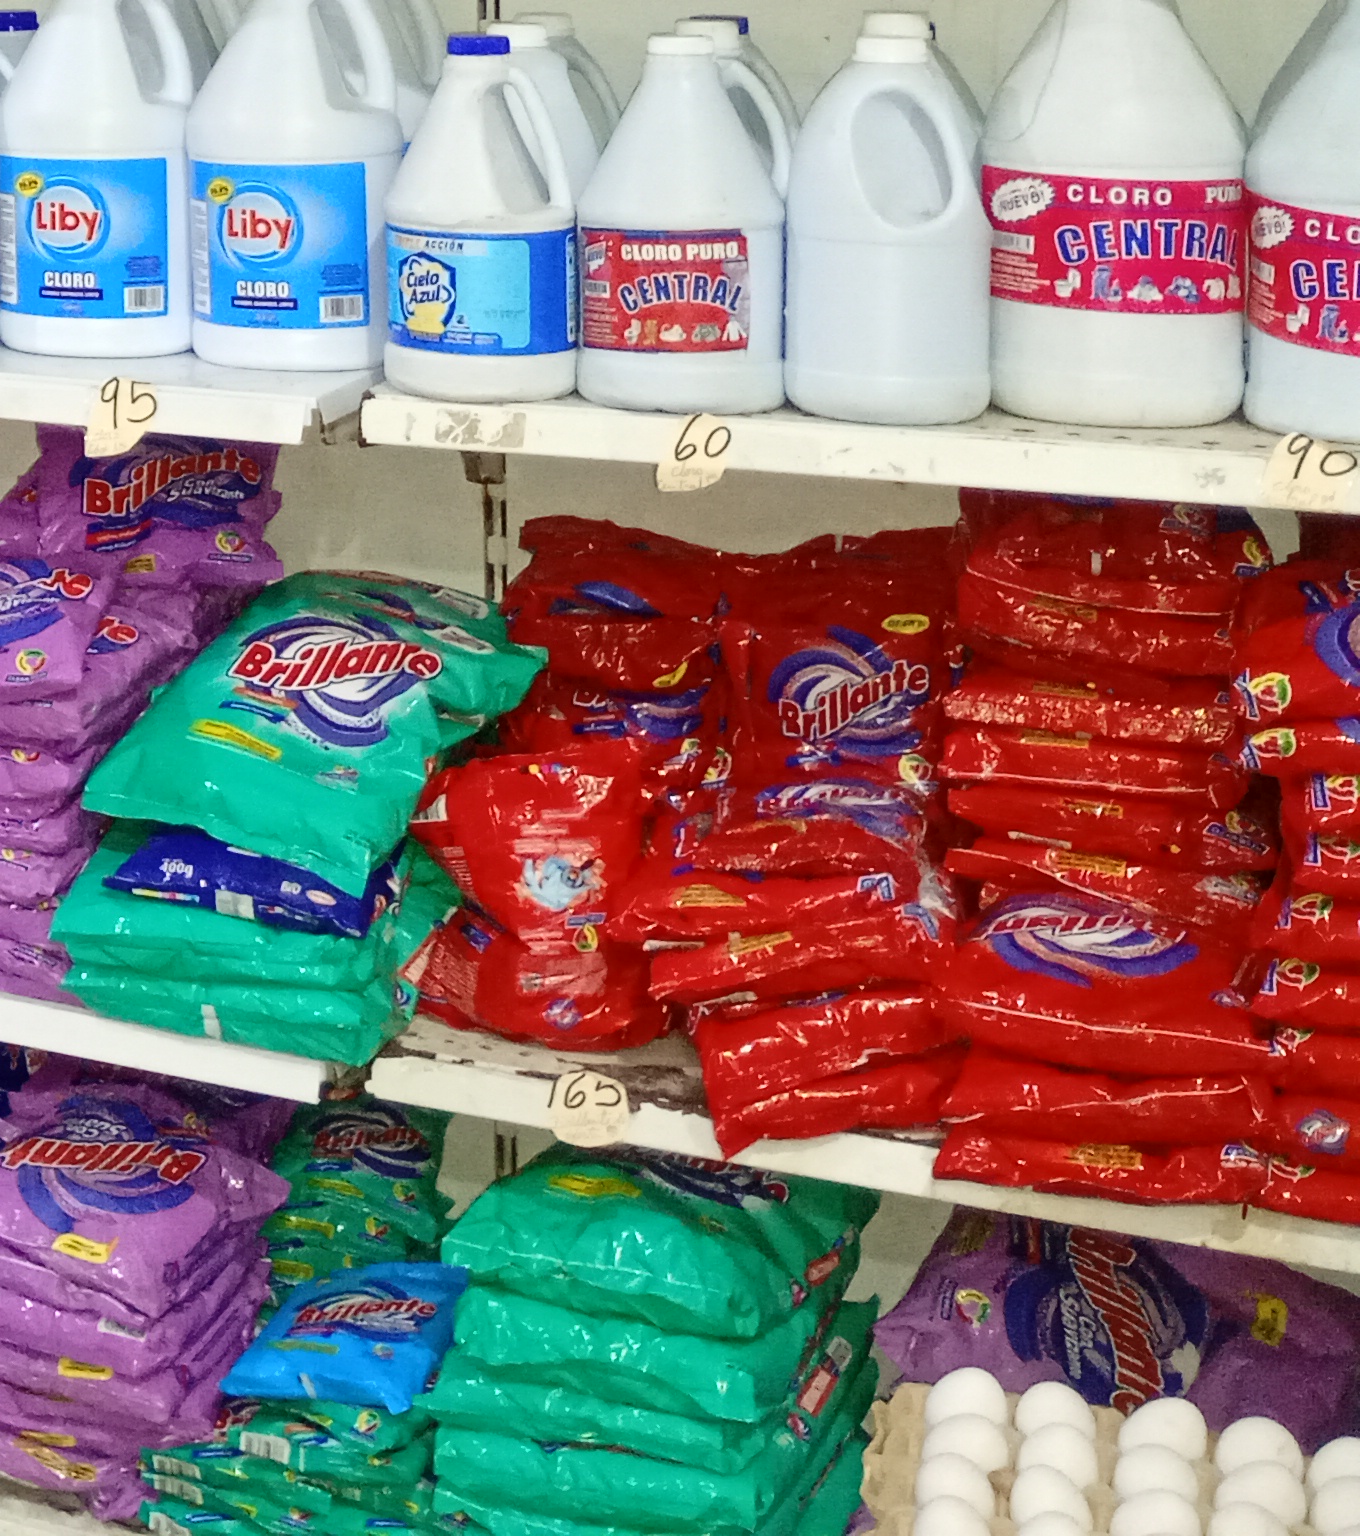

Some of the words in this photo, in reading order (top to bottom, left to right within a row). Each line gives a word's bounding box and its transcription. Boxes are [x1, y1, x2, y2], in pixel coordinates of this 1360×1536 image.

[1066, 183, 1174, 208] CLORO
[1204, 184, 1242, 205] PURO
[35, 201, 103, 242] Liby
[226, 208, 294, 250] Liby
[620, 242, 682, 263] CLORO
[686, 240, 739, 262] PURO
[1054, 218, 1241, 271] CENTRAL
[43, 270, 96, 289] CLORO
[236, 280, 289, 299] CLORO
[406, 269, 440, 288] Cielo
[409, 284, 442, 306] Azul
[617, 271, 746, 315] CENTRAL
[100, 376, 159, 424] 95
[673, 413, 733, 462] 60
[1286, 433, 1359, 481] 90
[82, 447, 262, 517] Brillante
[228, 637, 444, 690] Brillante
[778, 659, 929, 741] Brillante
[546, 1076, 624, 1113] 165
[295, 1299, 437, 1325] Brillante
